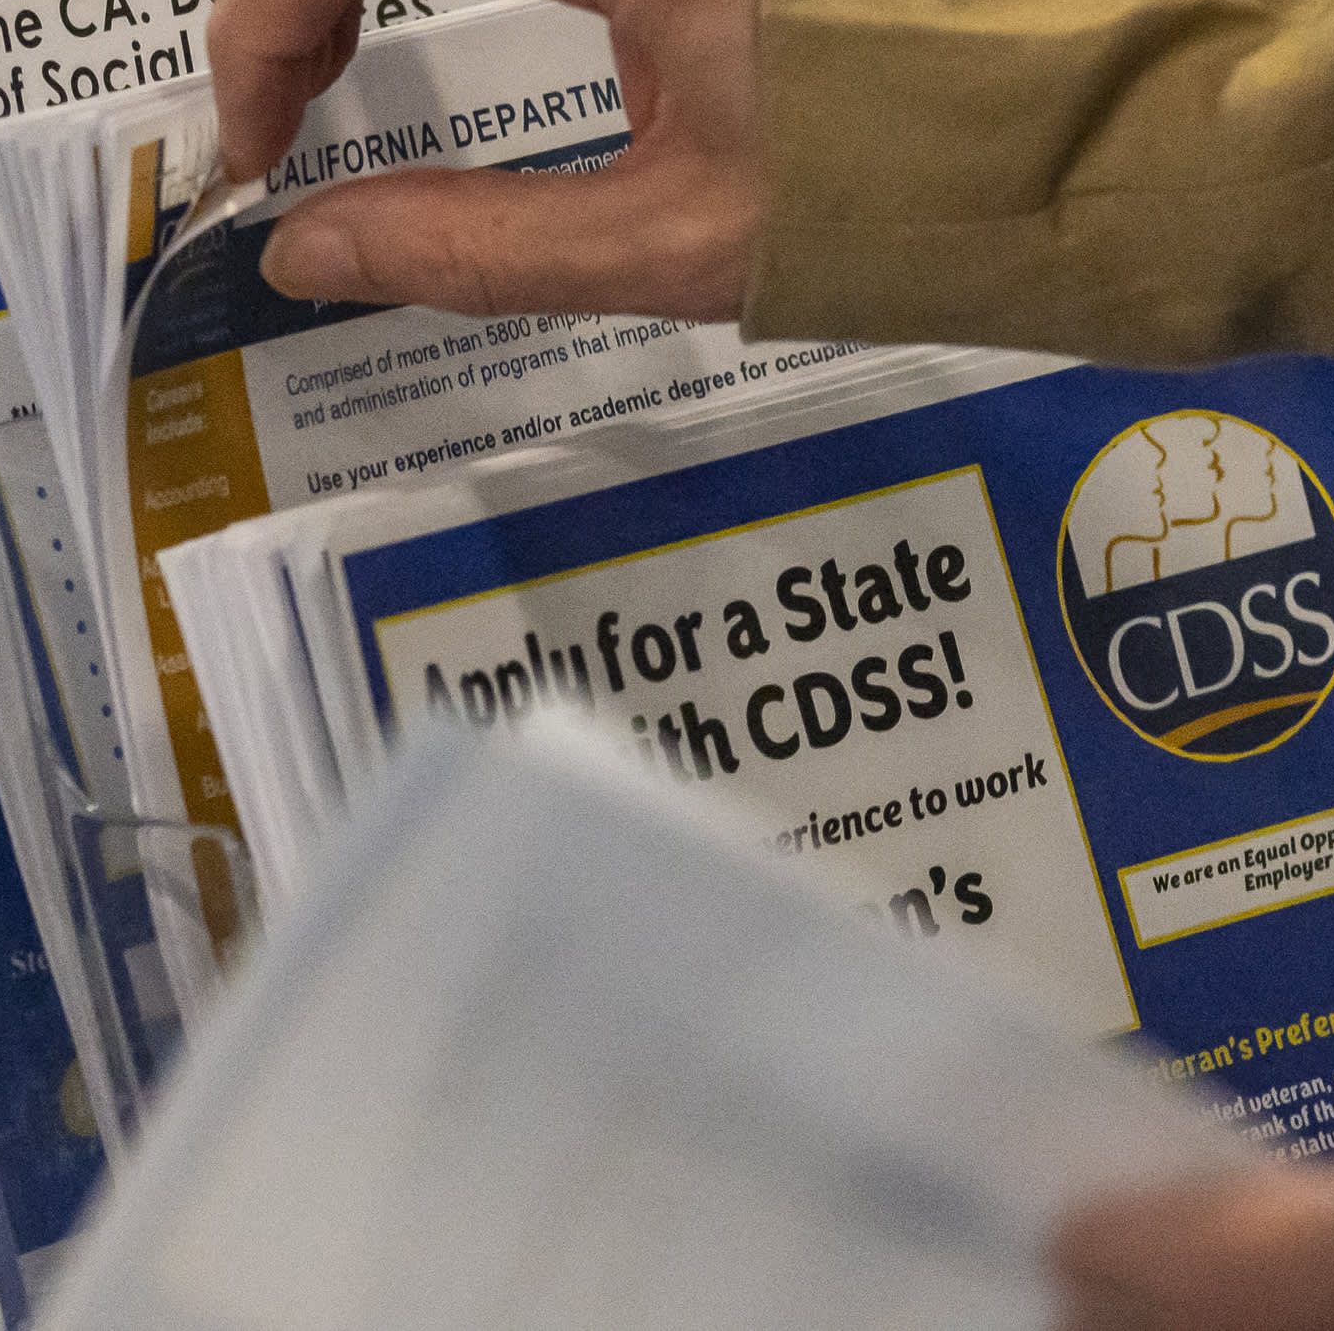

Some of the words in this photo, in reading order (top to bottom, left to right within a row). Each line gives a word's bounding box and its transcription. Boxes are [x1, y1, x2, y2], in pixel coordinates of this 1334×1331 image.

[41, 30, 194, 107] Social
[449, 77, 623, 149] DEPARTM
[286, 356, 373, 397] Comprised
[376, 349, 392, 374] of
[397, 343, 441, 369] more
[443, 332, 483, 357] than
[485, 317, 532, 347] 5800
[294, 404, 326, 430] and
[330, 373, 454, 421] administration
[458, 366, 476, 388] of
[480, 344, 569, 386] programs
[572, 331, 611, 359] that
[614, 319, 681, 349] impact
[307, 473, 344, 494] Use
[347, 459, 389, 490] your
[394, 432, 497, 472] experience
[501, 414, 563, 445] and/or
[570, 387, 663, 427] academic
[668, 371, 736, 402] degree
[739, 360, 769, 382] for
[597, 610, 703, 693] for
[723, 599, 771, 660] a
[776, 538, 972, 643] State
[630, 700, 741, 781] ith
[746, 630, 974, 761] CDSS!
[909, 786, 947, 820] to
[955, 752, 1048, 807] work
[1153, 872, 1180, 894] We
[1184, 864, 1214, 885] are
[1217, 856, 1242, 876] an
[1244, 836, 1297, 869] Equal
[1244, 854, 1334, 892] Employer
[1250, 1074, 1332, 1116] veteran,
[1290, 1107, 1310, 1132] of
